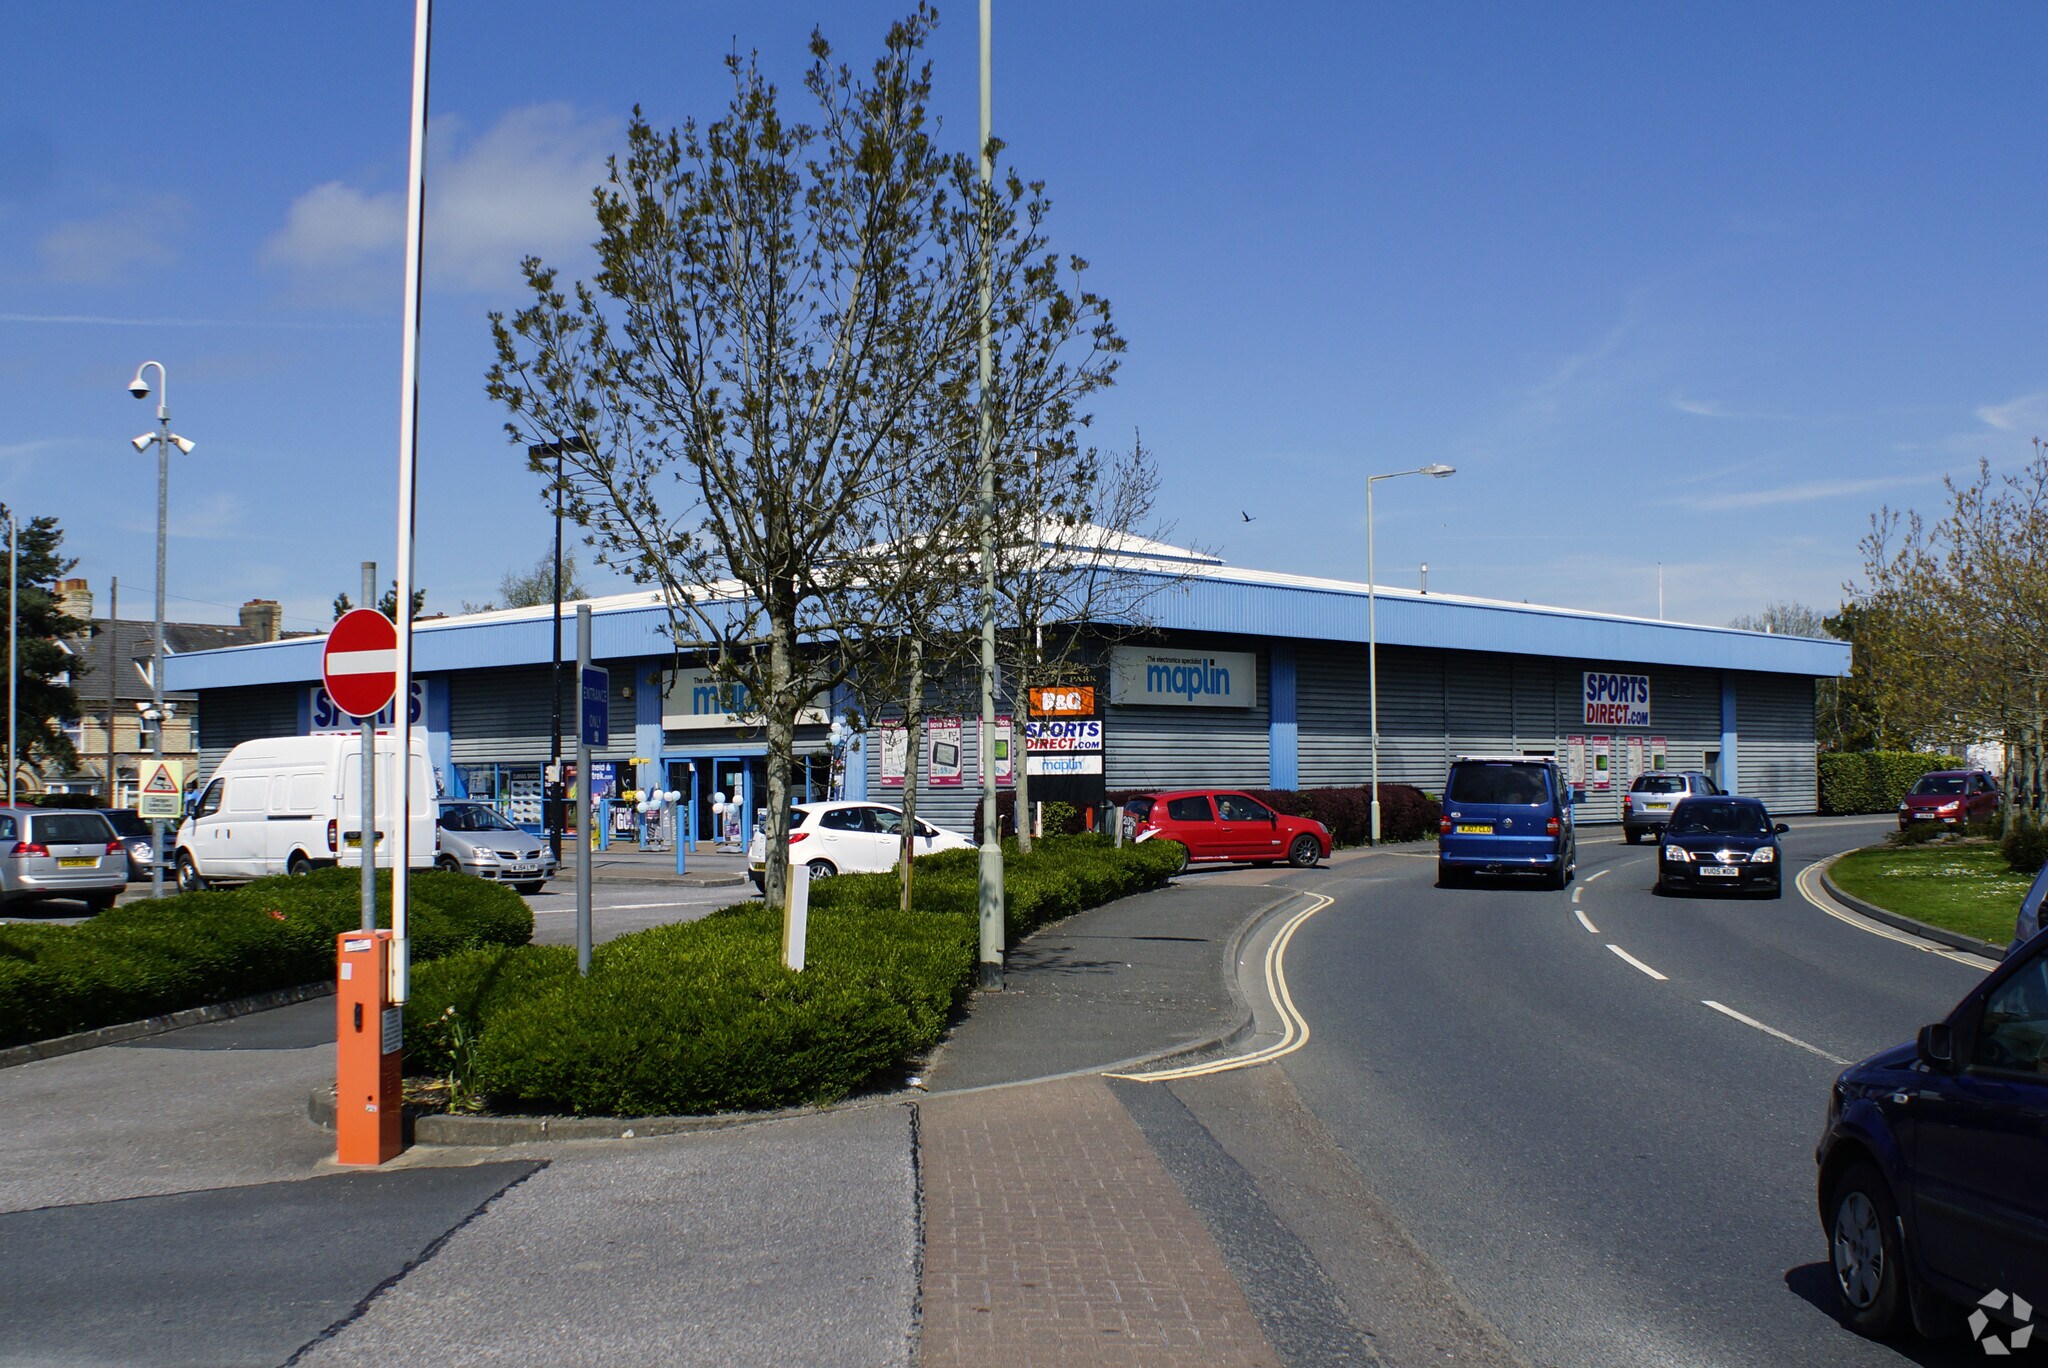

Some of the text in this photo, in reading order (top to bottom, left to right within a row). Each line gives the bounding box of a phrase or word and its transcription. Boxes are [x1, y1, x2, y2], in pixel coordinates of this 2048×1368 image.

[1069, 675, 1097, 683] PARK
[1147, 658, 1230, 701] maplin
[583, 686, 607, 703] ENTRANCE
[1586, 673, 1648, 704] SPORTS
[1042, 692, 1081, 711] B&Q
[1586, 703, 1649, 725] DIRECT.COM
[1025, 722, 1100, 738] SPORTS
[1026, 738, 1100, 750] DIRECT.COM
[1042, 757, 1083, 772] maplin
